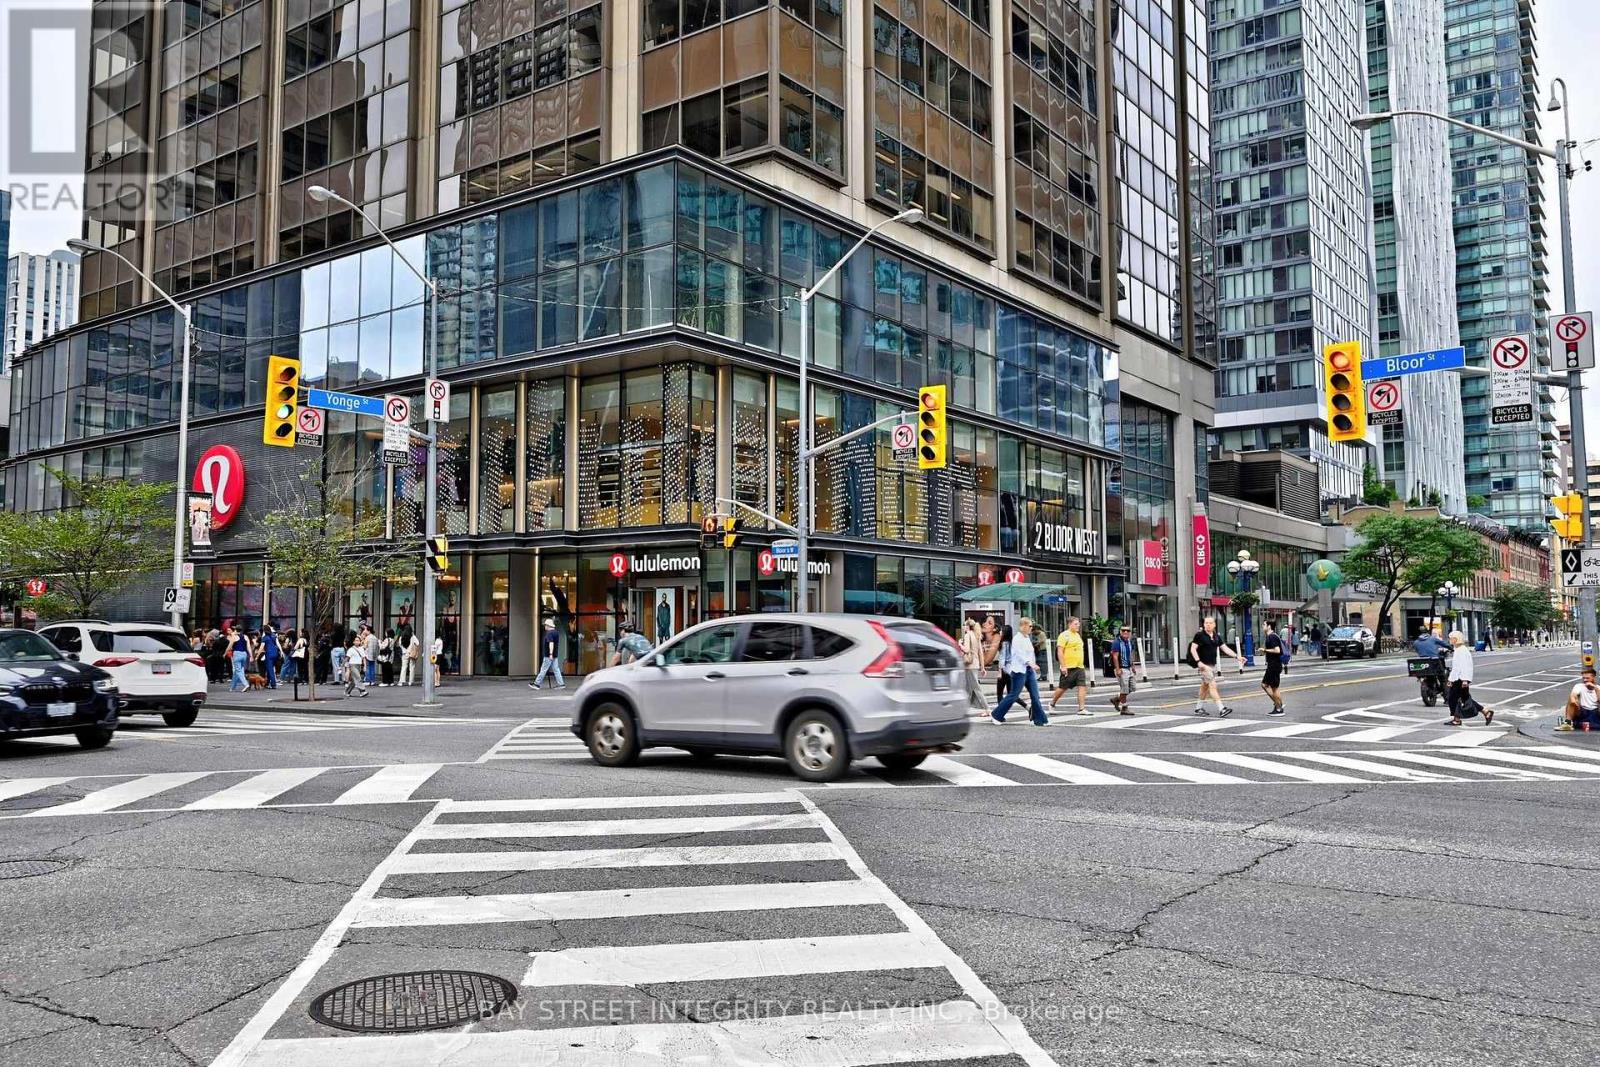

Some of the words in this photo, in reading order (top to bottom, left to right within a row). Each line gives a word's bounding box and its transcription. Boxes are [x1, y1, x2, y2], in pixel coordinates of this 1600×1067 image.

[1386, 357, 1425, 372] Bloor
[326, 393, 360, 410] Yonge
[1496, 405, 1528, 414] BICYCLES
[1494, 413, 1530, 422] EXCEPTED
[1034, 521, 1042, 549] 2
[1044, 523, 1074, 553] BLOOR
[1075, 527, 1097, 556] WEST
[631, 553, 700, 573] lululemon
[1145, 556, 1157, 569] CIBC
[1196, 544, 1206, 566] CIBC
[777, 557, 830, 575] lulumon
